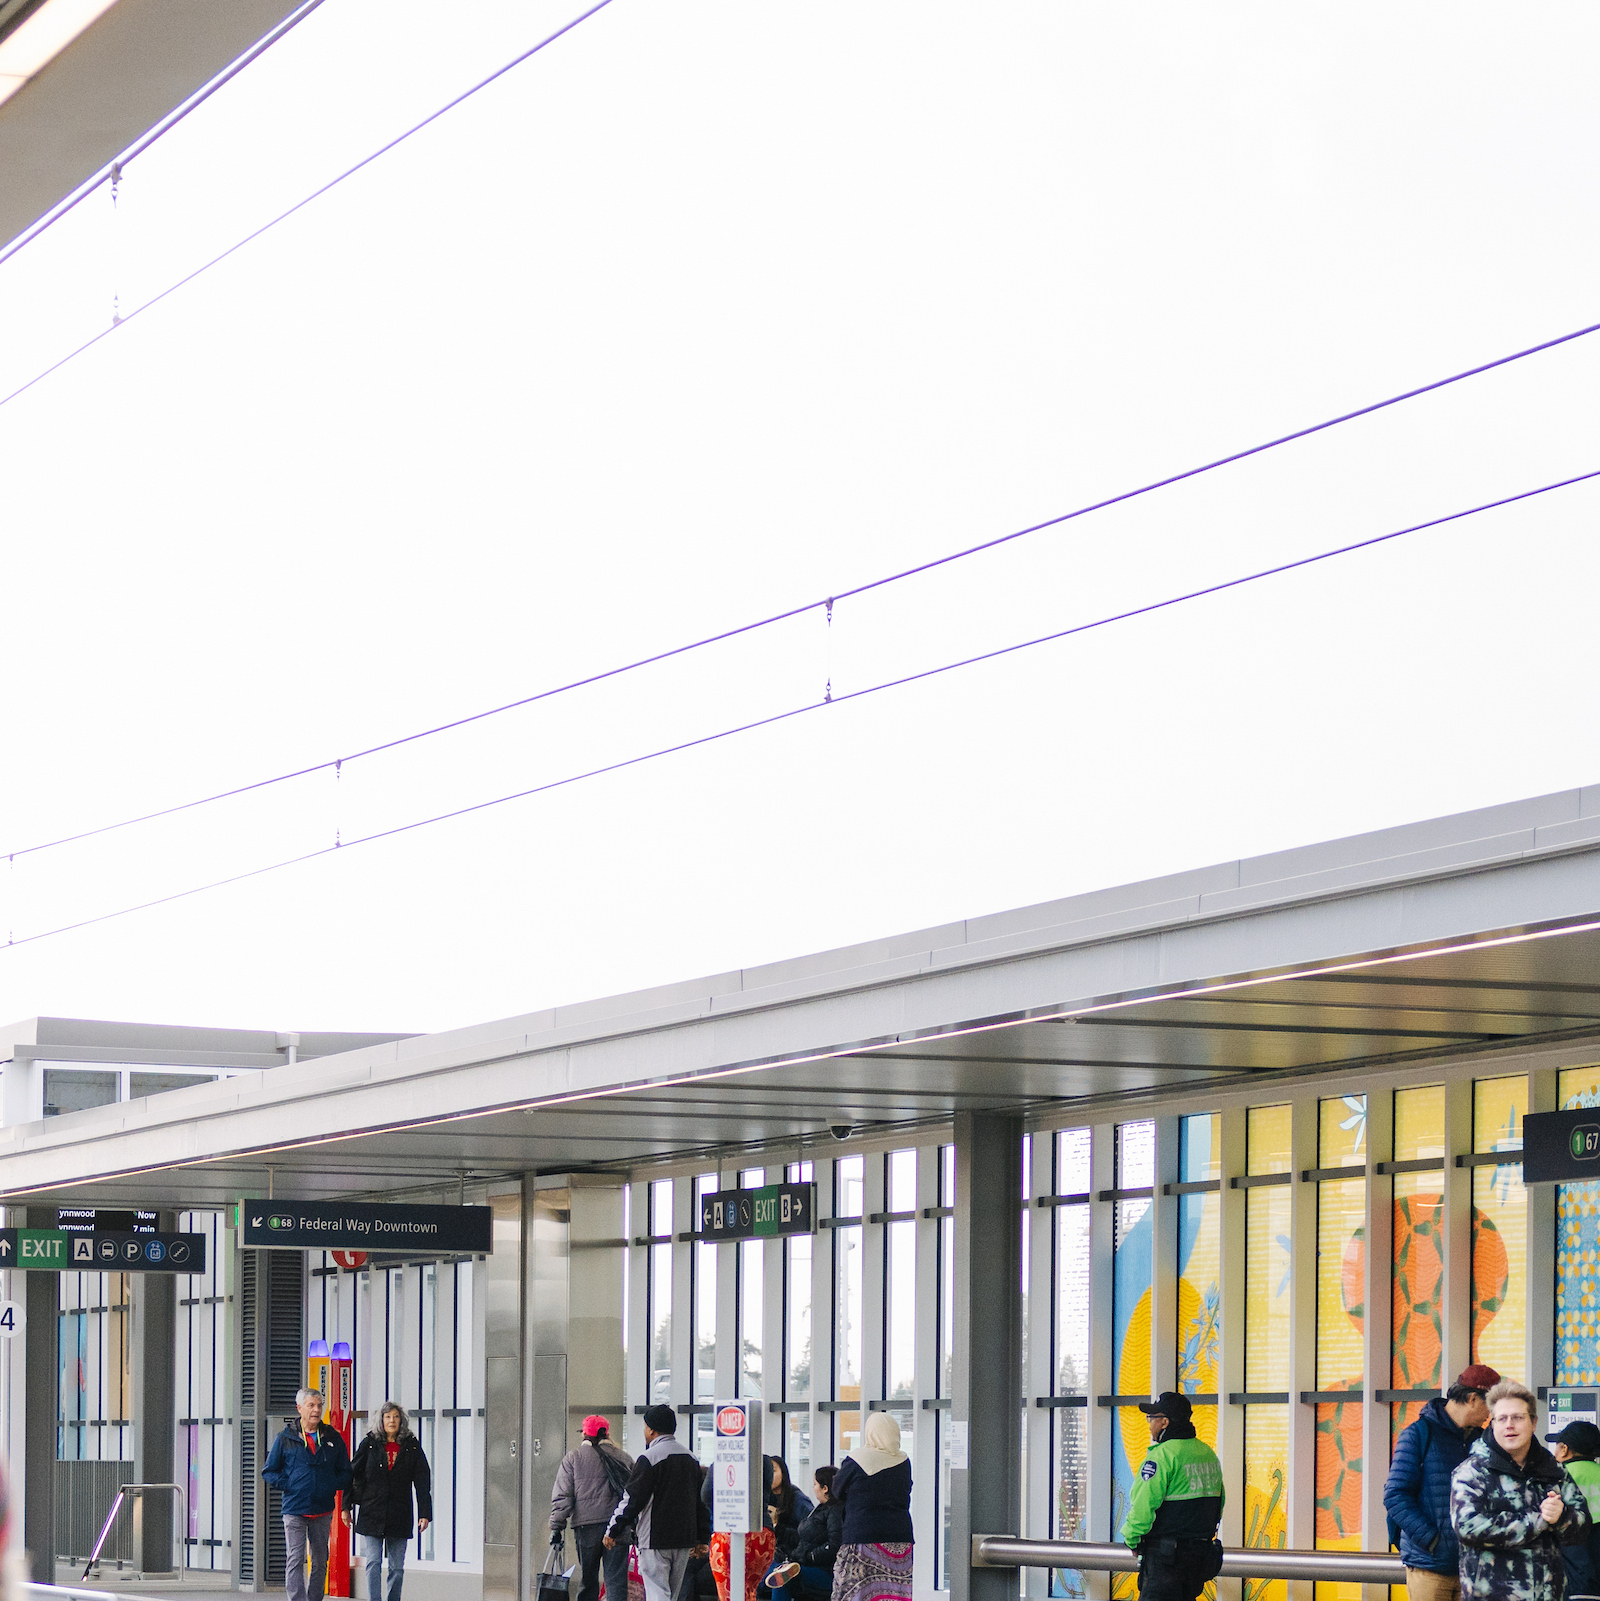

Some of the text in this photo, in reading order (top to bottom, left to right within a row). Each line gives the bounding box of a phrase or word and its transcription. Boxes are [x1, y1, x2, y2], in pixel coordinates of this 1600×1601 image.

[1576, 1134, 1581, 1151] 1
[1586, 1132, 1599, 1150] 67
[58, 1209, 156, 1220] ynnwood Now
[755, 1199, 776, 1222] EXIT
[281, 1218, 292, 1228] 68
[300, 1217, 343, 1231] Federal
[346, 1219, 371, 1234] Way
[374, 1219, 438, 1234] Downtown
[22, 1239, 62, 1258] EXIT
[78, 1242, 90, 1257] A
[0, 1306, 16, 1331] 4
[1558, 1398, 1571, 1408] EXIT
[721, 1413, 742, 1430] DANGER
